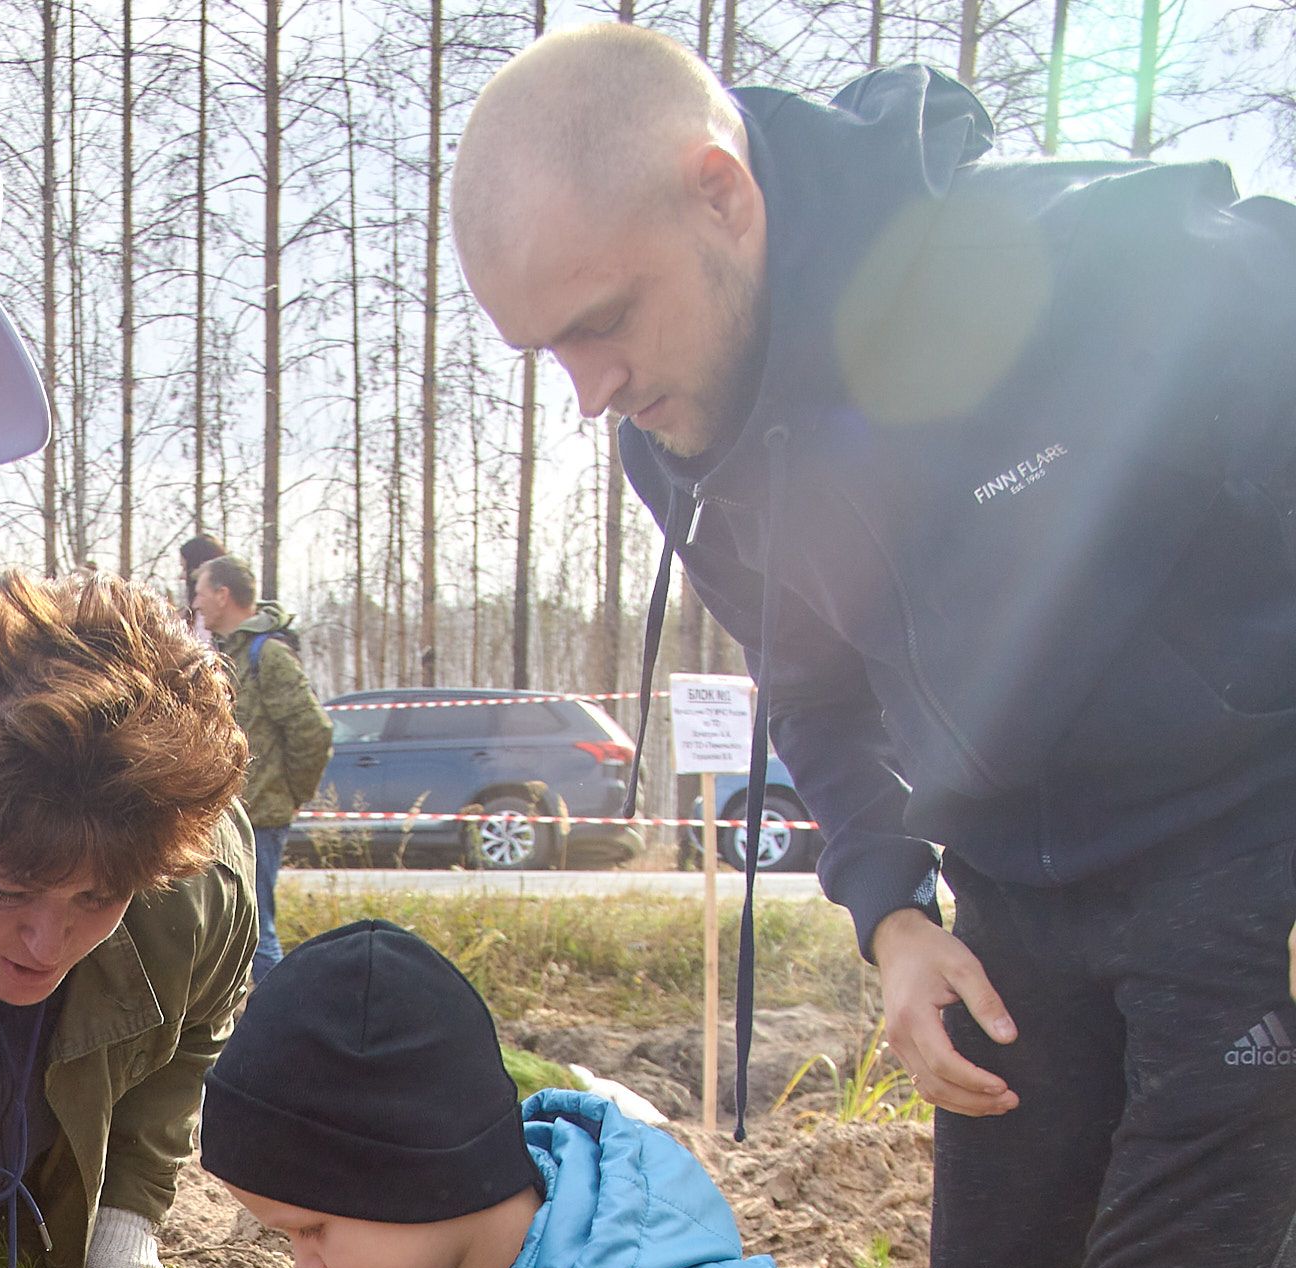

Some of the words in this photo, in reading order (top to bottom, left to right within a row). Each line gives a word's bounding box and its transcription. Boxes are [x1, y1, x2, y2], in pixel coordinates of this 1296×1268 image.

[973, 469, 1018, 504] FINN
[1016, 443, 1068, 478] FLARE
[688, 688, 714, 700] БЛОК
